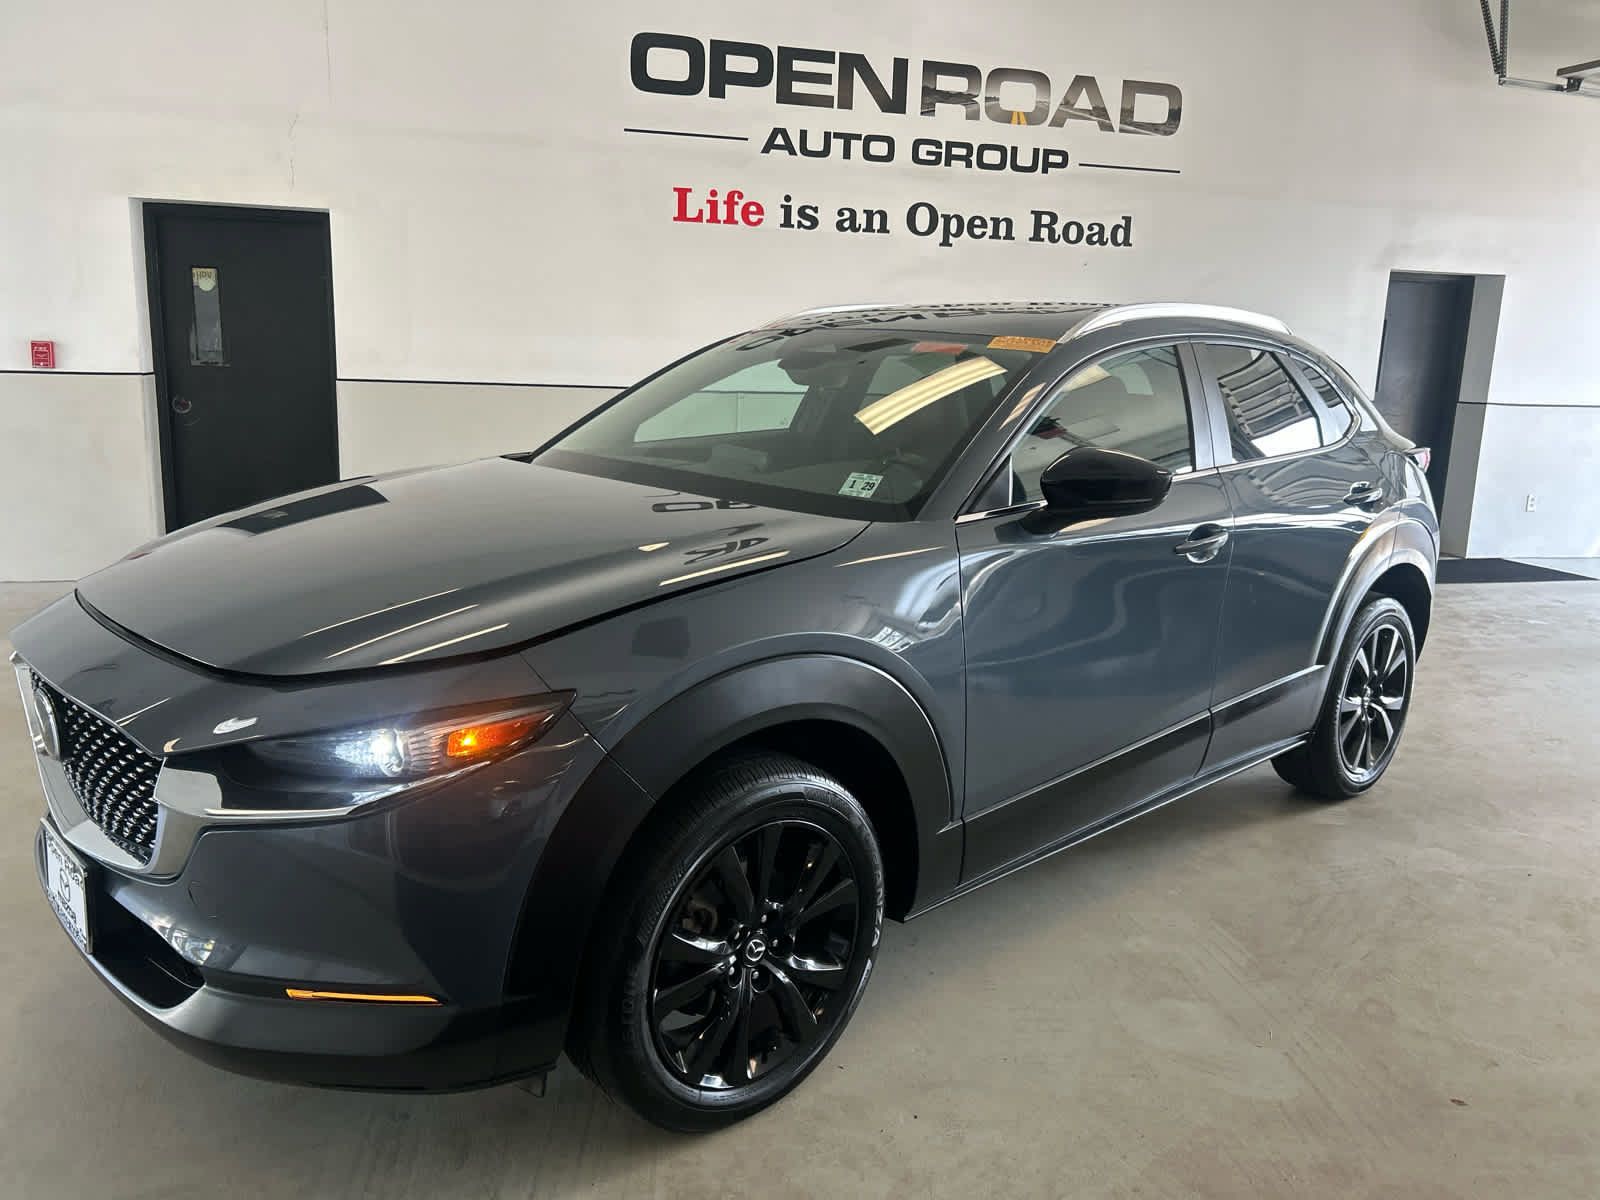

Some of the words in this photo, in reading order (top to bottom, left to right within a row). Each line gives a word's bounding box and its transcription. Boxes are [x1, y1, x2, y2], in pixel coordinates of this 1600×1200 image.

[630, 32, 909, 115] OPEN
[920, 60, 1183, 137] ROAD
[760, 128, 895, 162] AUTO
[912, 138, 1069, 174] GROUP
[673, 187, 765, 227] Life
[780, 194, 819, 230] is
[836, 208, 890, 235] an
[906, 202, 1016, 247] Open
[1029, 210, 1133, 247] Road
[848, 479, 857, 488] 1
[860, 481, 876, 491] 29
